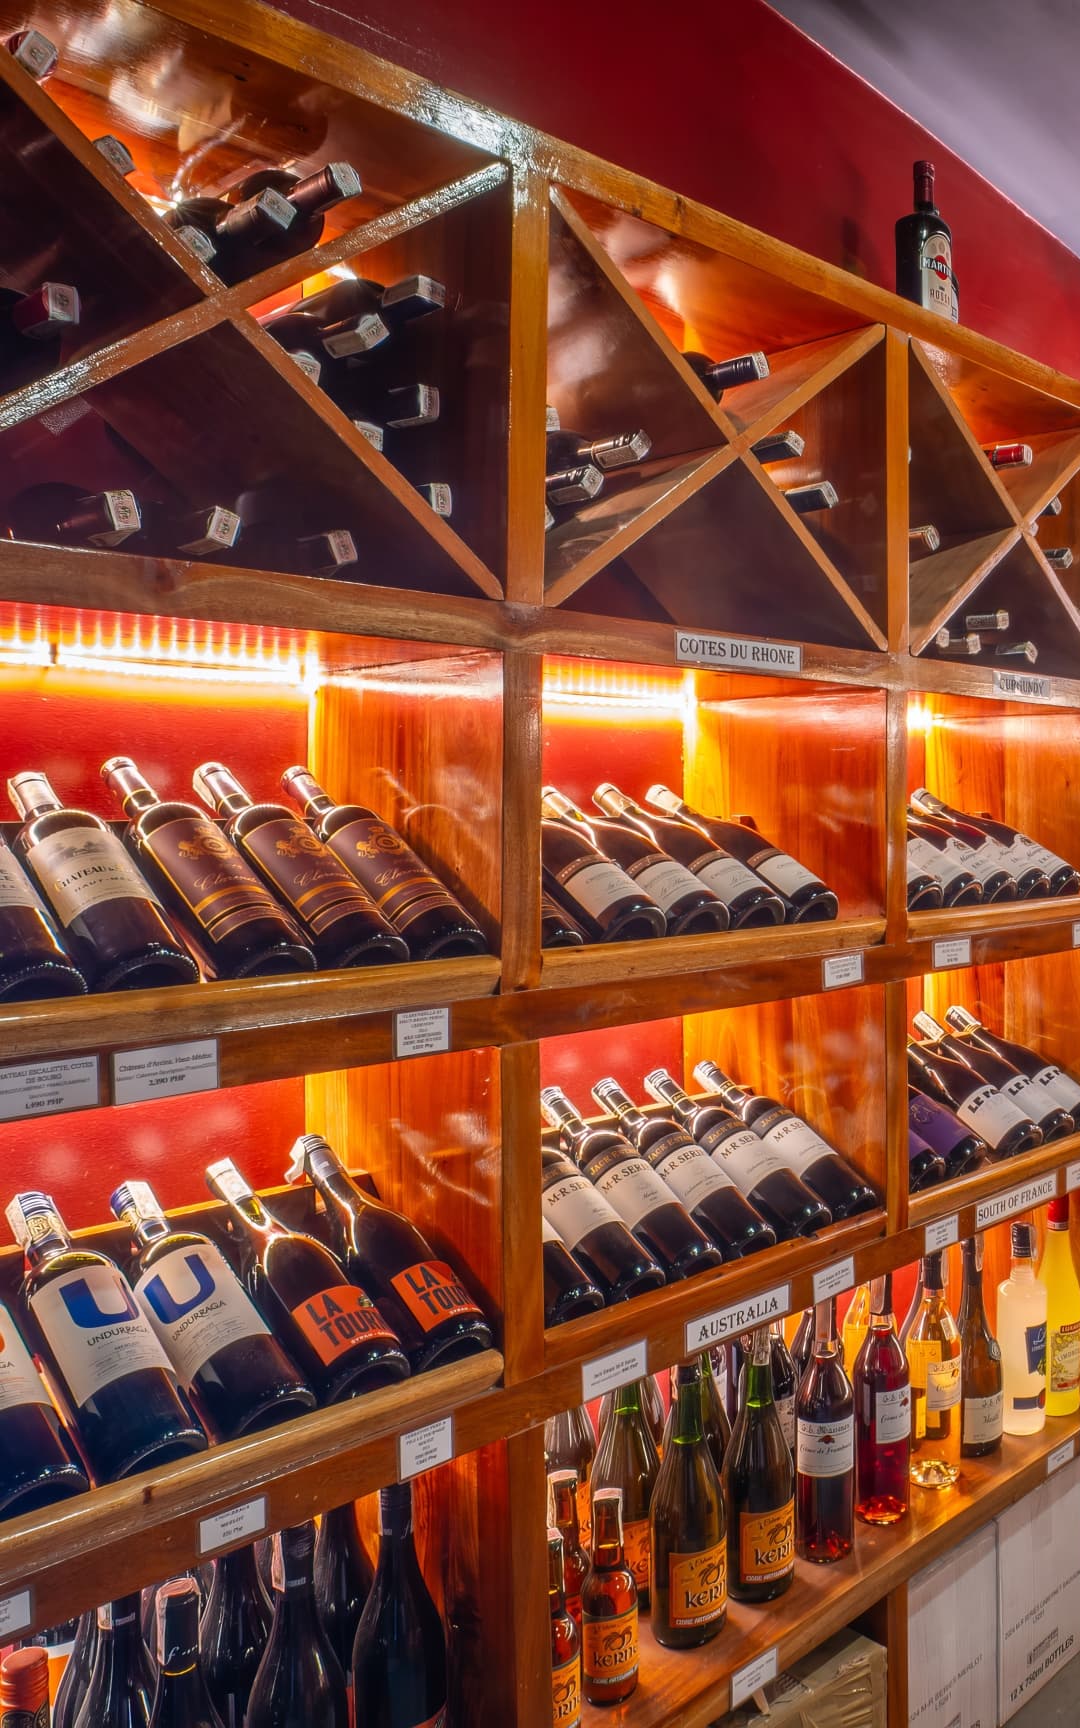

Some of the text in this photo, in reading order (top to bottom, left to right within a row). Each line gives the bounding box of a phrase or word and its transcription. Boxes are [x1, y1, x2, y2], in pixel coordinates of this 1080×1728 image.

[922, 257, 952, 279] MARTI
[679, 637, 795, 665] COTES DU RHONE
[968, 1094, 984, 1114] LE
[977, 1180, 1053, 1222] SOUTH OF FRANCE
[142, 1253, 216, 1325] U
[404, 1265, 441, 1295] LA
[58, 1277, 140, 1329] U
[171, 1300, 228, 1342] UNDURRAGA
[304, 1293, 344, 1327] LA
[697, 1296, 779, 1343] AUSTRALIA
[1009, 1690, 1018, 1702] 12
[1024, 1663, 1044, 1689] 750ml
[1044, 1634, 1074, 1668] BOTTLES
